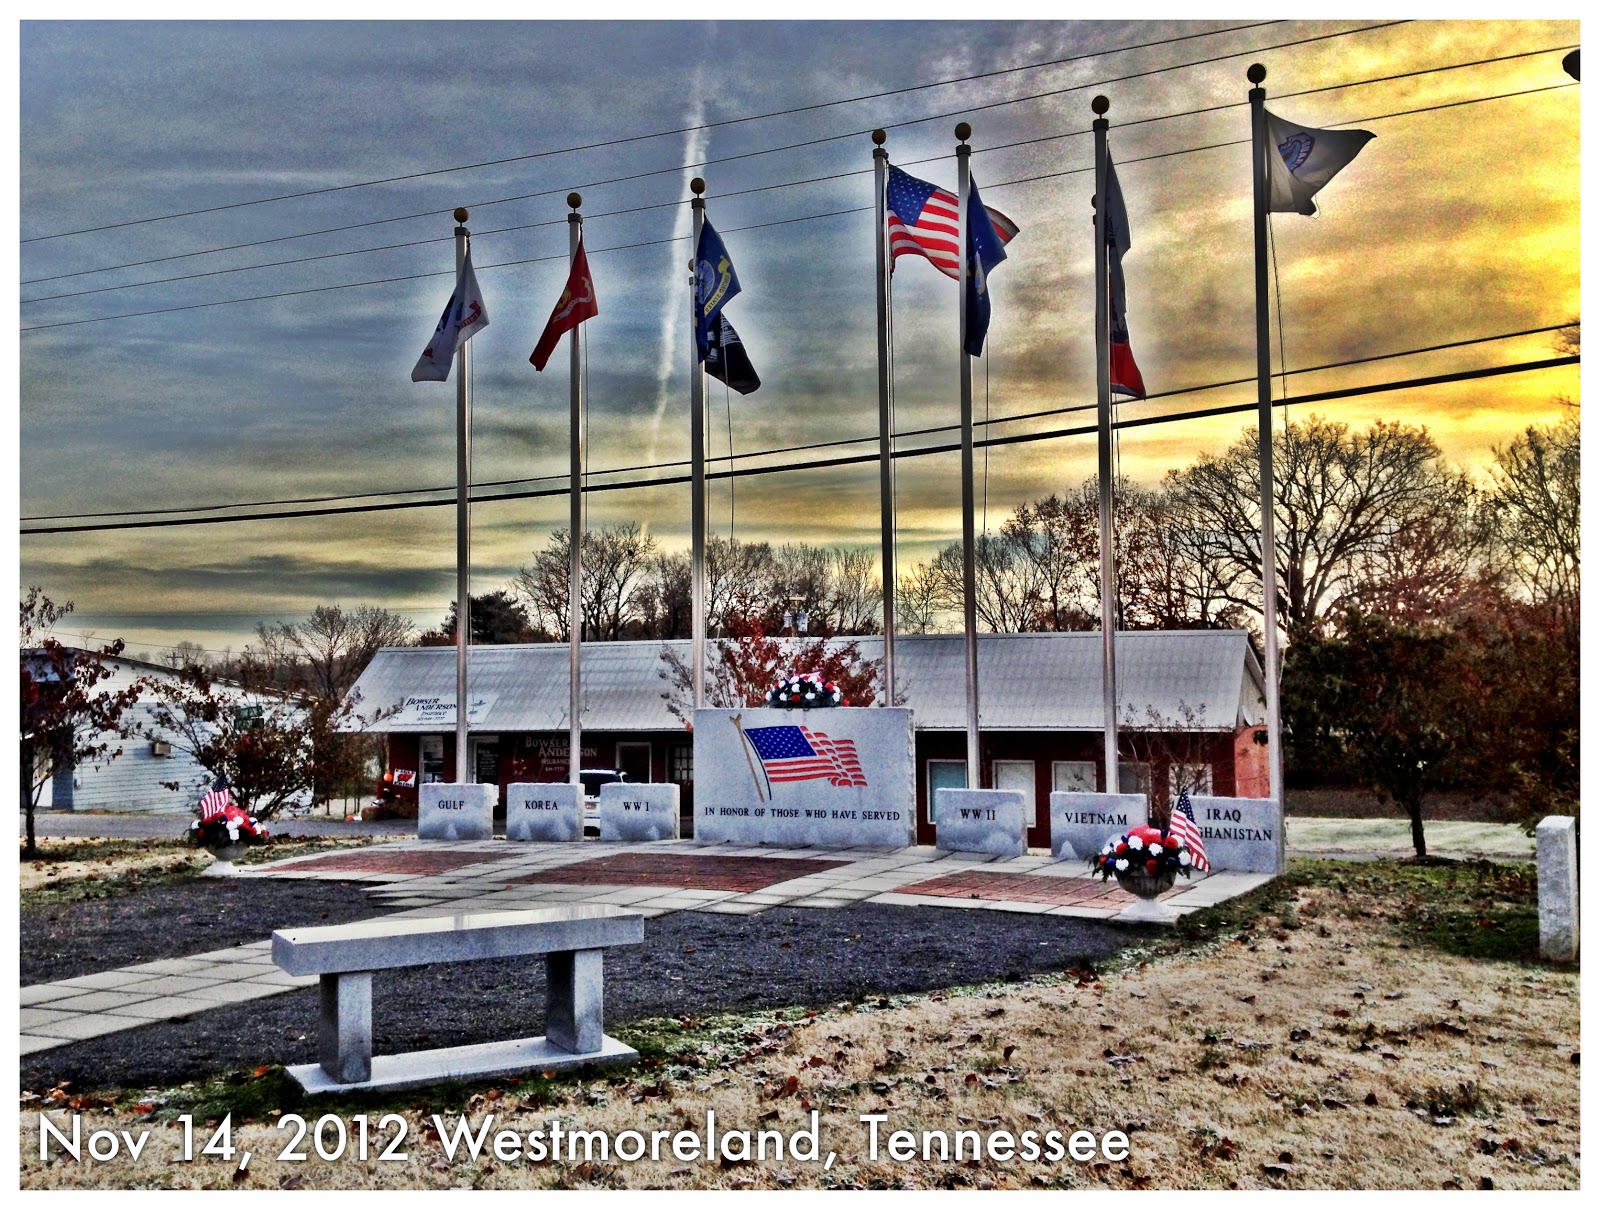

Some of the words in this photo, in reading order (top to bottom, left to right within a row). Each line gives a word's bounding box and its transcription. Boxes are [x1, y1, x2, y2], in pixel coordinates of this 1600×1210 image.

[405, 698, 440, 706] BOWSER
[525, 736, 569, 748] BOWSER
[538, 747, 598, 757] ANDESON
[438, 800, 464, 810] GULF
[525, 800, 559, 811] KOREA
[705, 807, 715, 815] IN
[720, 807, 749, 816] HONOR
[755, 808, 766, 817] OF
[771, 808, 800, 818] THOSE
[805, 809, 827, 819] WHO
[832, 810, 857, 820] HAVE
[862, 811, 900, 821] SERVED
[1065, 812, 1128, 825] VIETNAM
[1206, 808, 1242, 823] IRAQ
[1197, 826, 1272, 841] GHANISTAN
